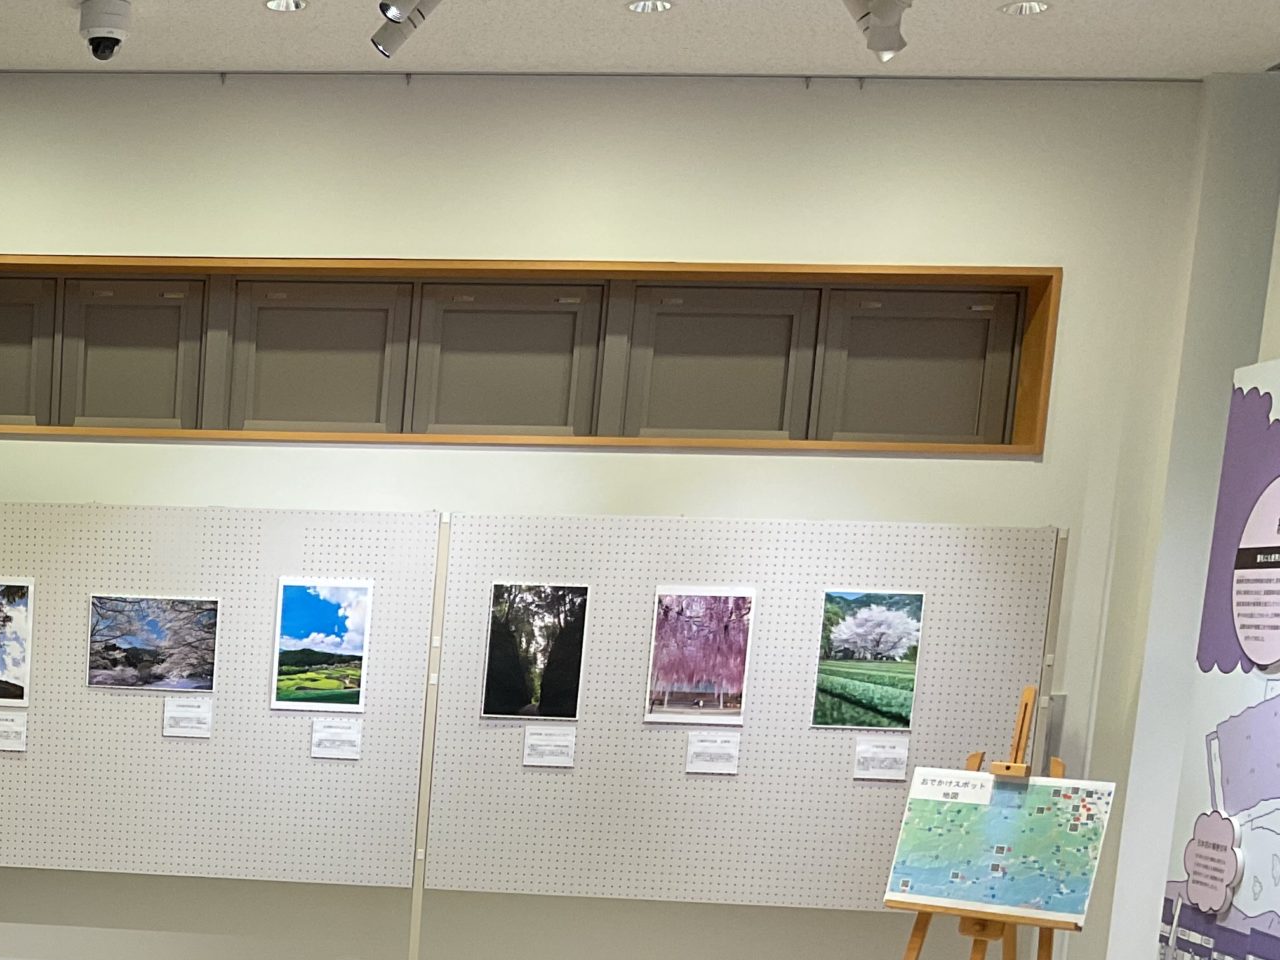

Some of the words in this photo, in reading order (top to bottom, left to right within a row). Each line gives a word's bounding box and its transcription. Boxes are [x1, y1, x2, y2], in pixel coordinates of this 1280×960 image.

[921, 778, 986, 789] おでかけスポット
